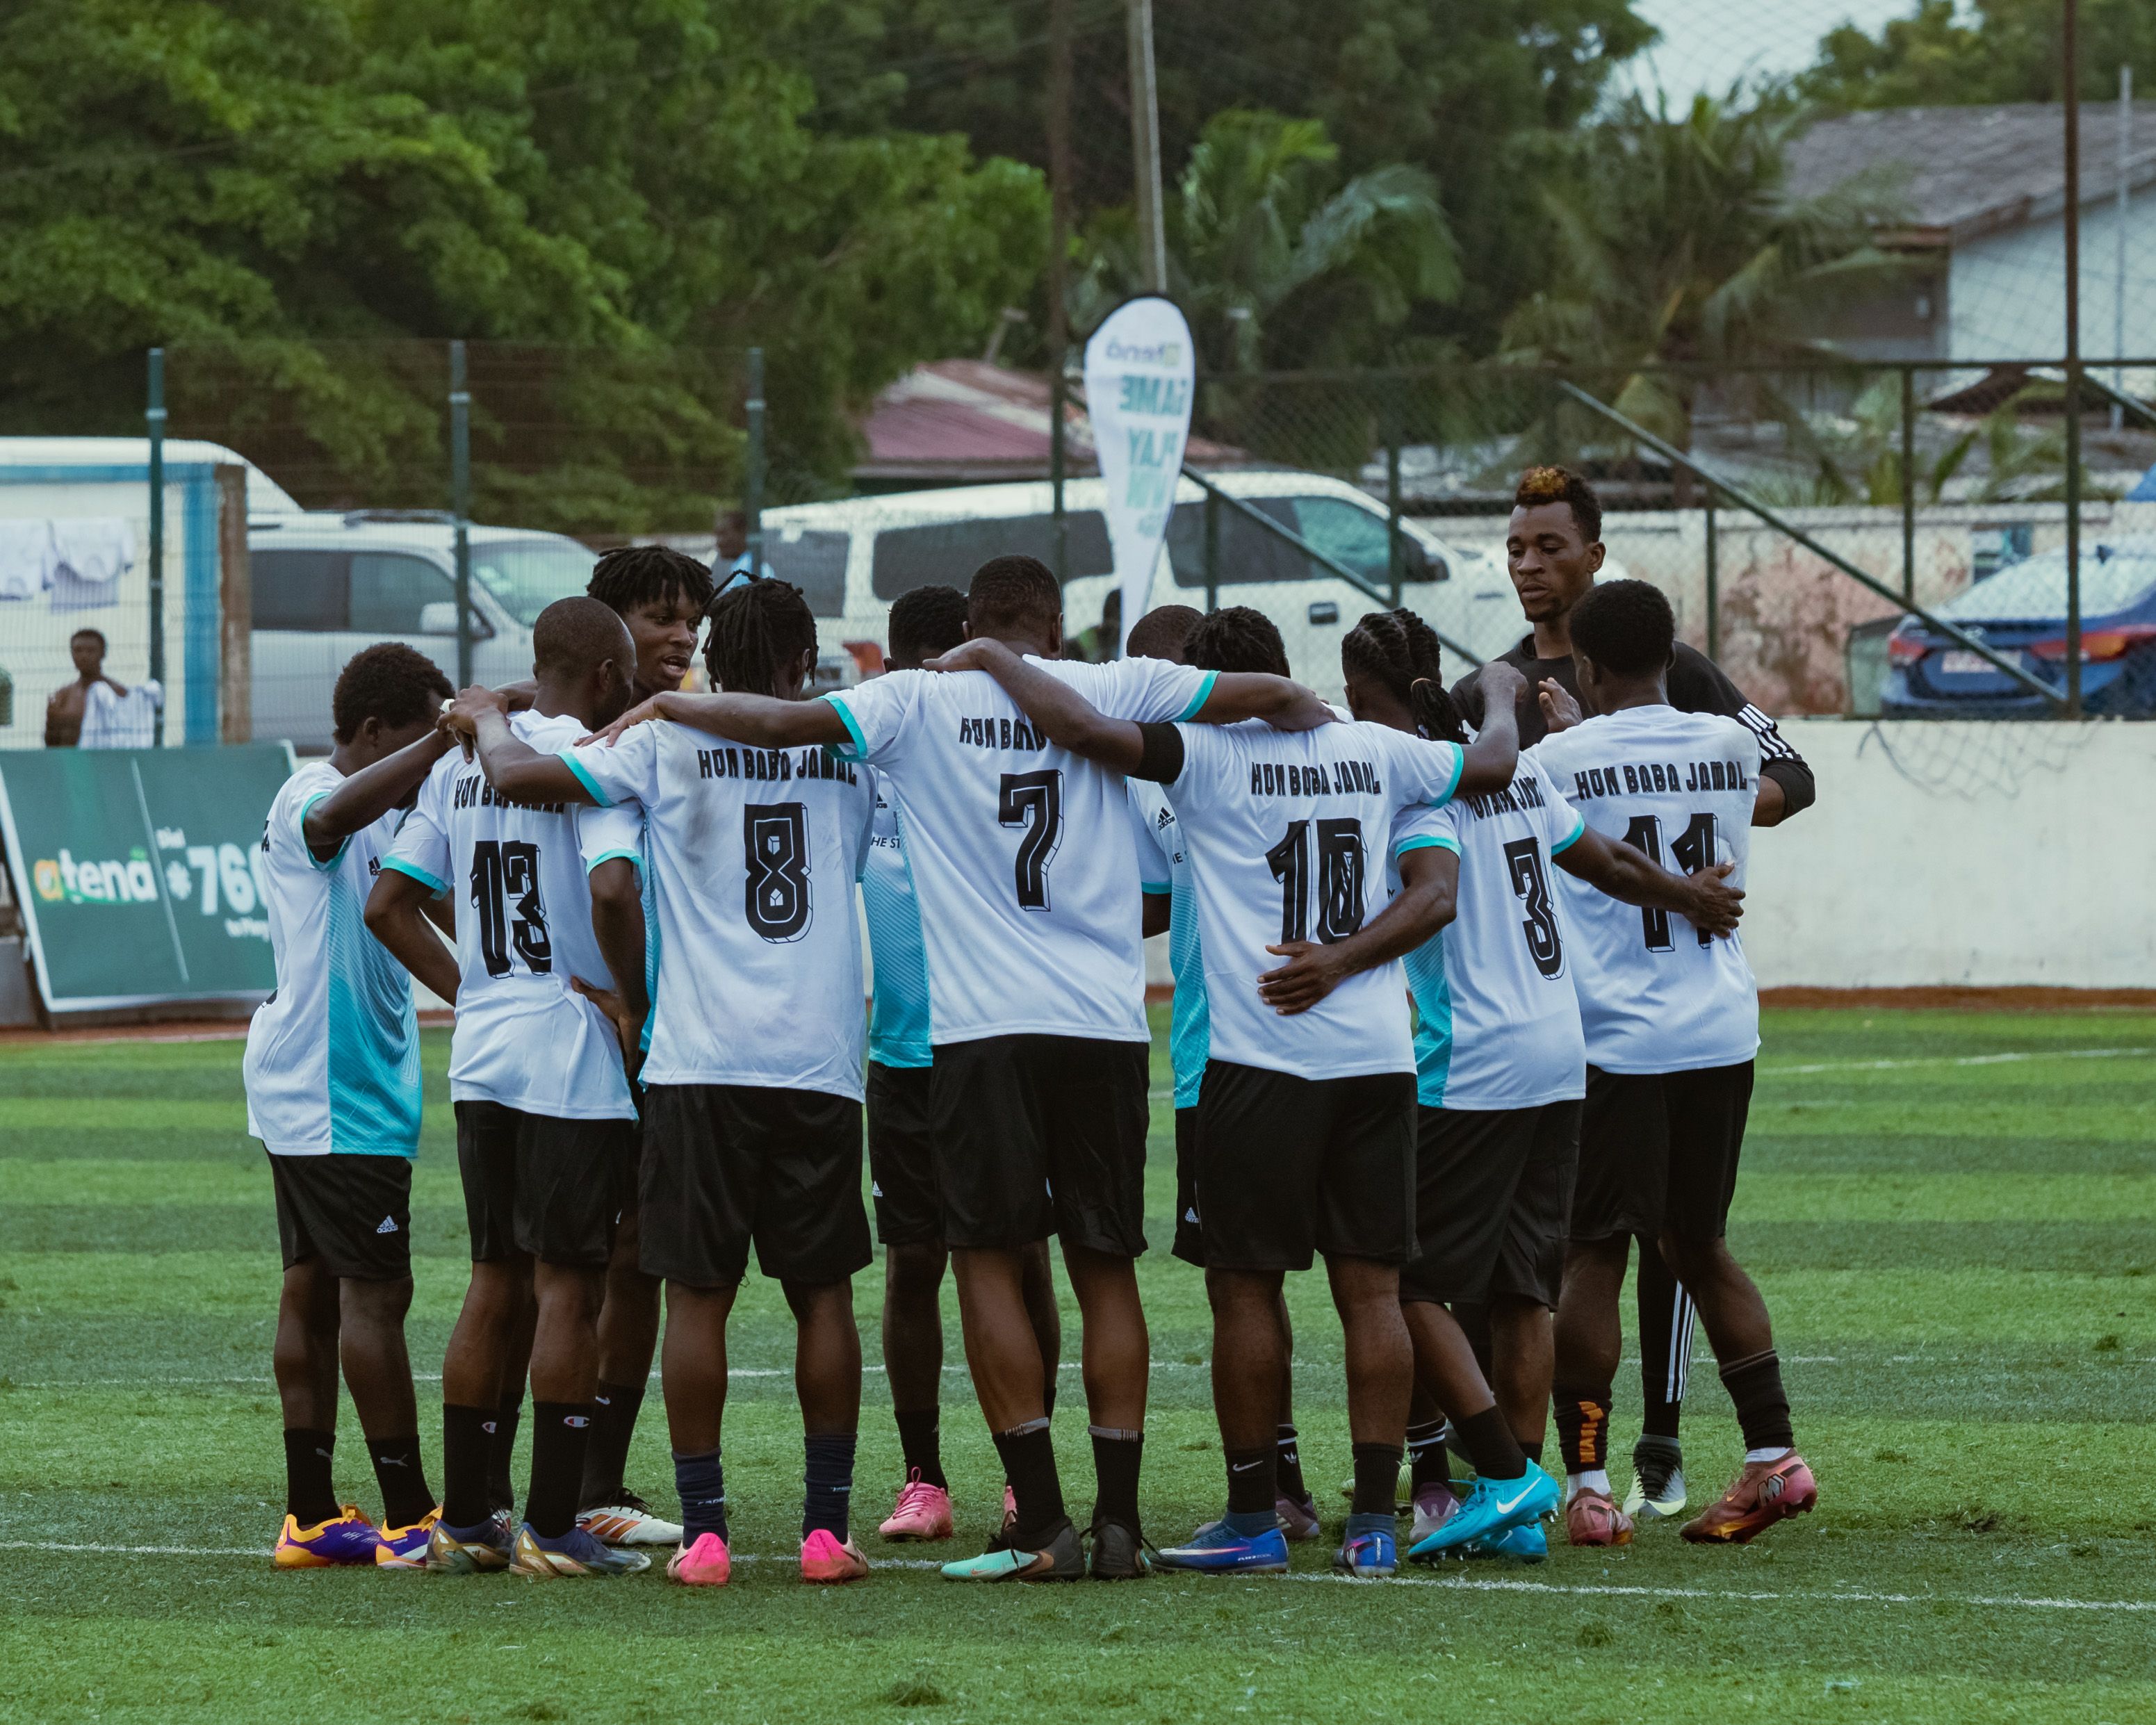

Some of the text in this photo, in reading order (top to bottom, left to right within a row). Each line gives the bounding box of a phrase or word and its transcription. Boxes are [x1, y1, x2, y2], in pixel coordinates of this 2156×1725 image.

[697, 748, 739, 779] HON
[742, 748, 792, 781] BABA
[1252, 762, 1286, 796] HON
[1288, 764, 1332, 796] BABA
[1574, 761, 1747, 801] HON BABA JAMAL
[470, 840, 553, 980] 13
[744, 802, 813, 944] 8
[998, 769, 1064, 912] 7
[1265, 817, 1369, 945] 10
[1503, 836, 1565, 981] 3
[1622, 812, 1720, 954] 11
